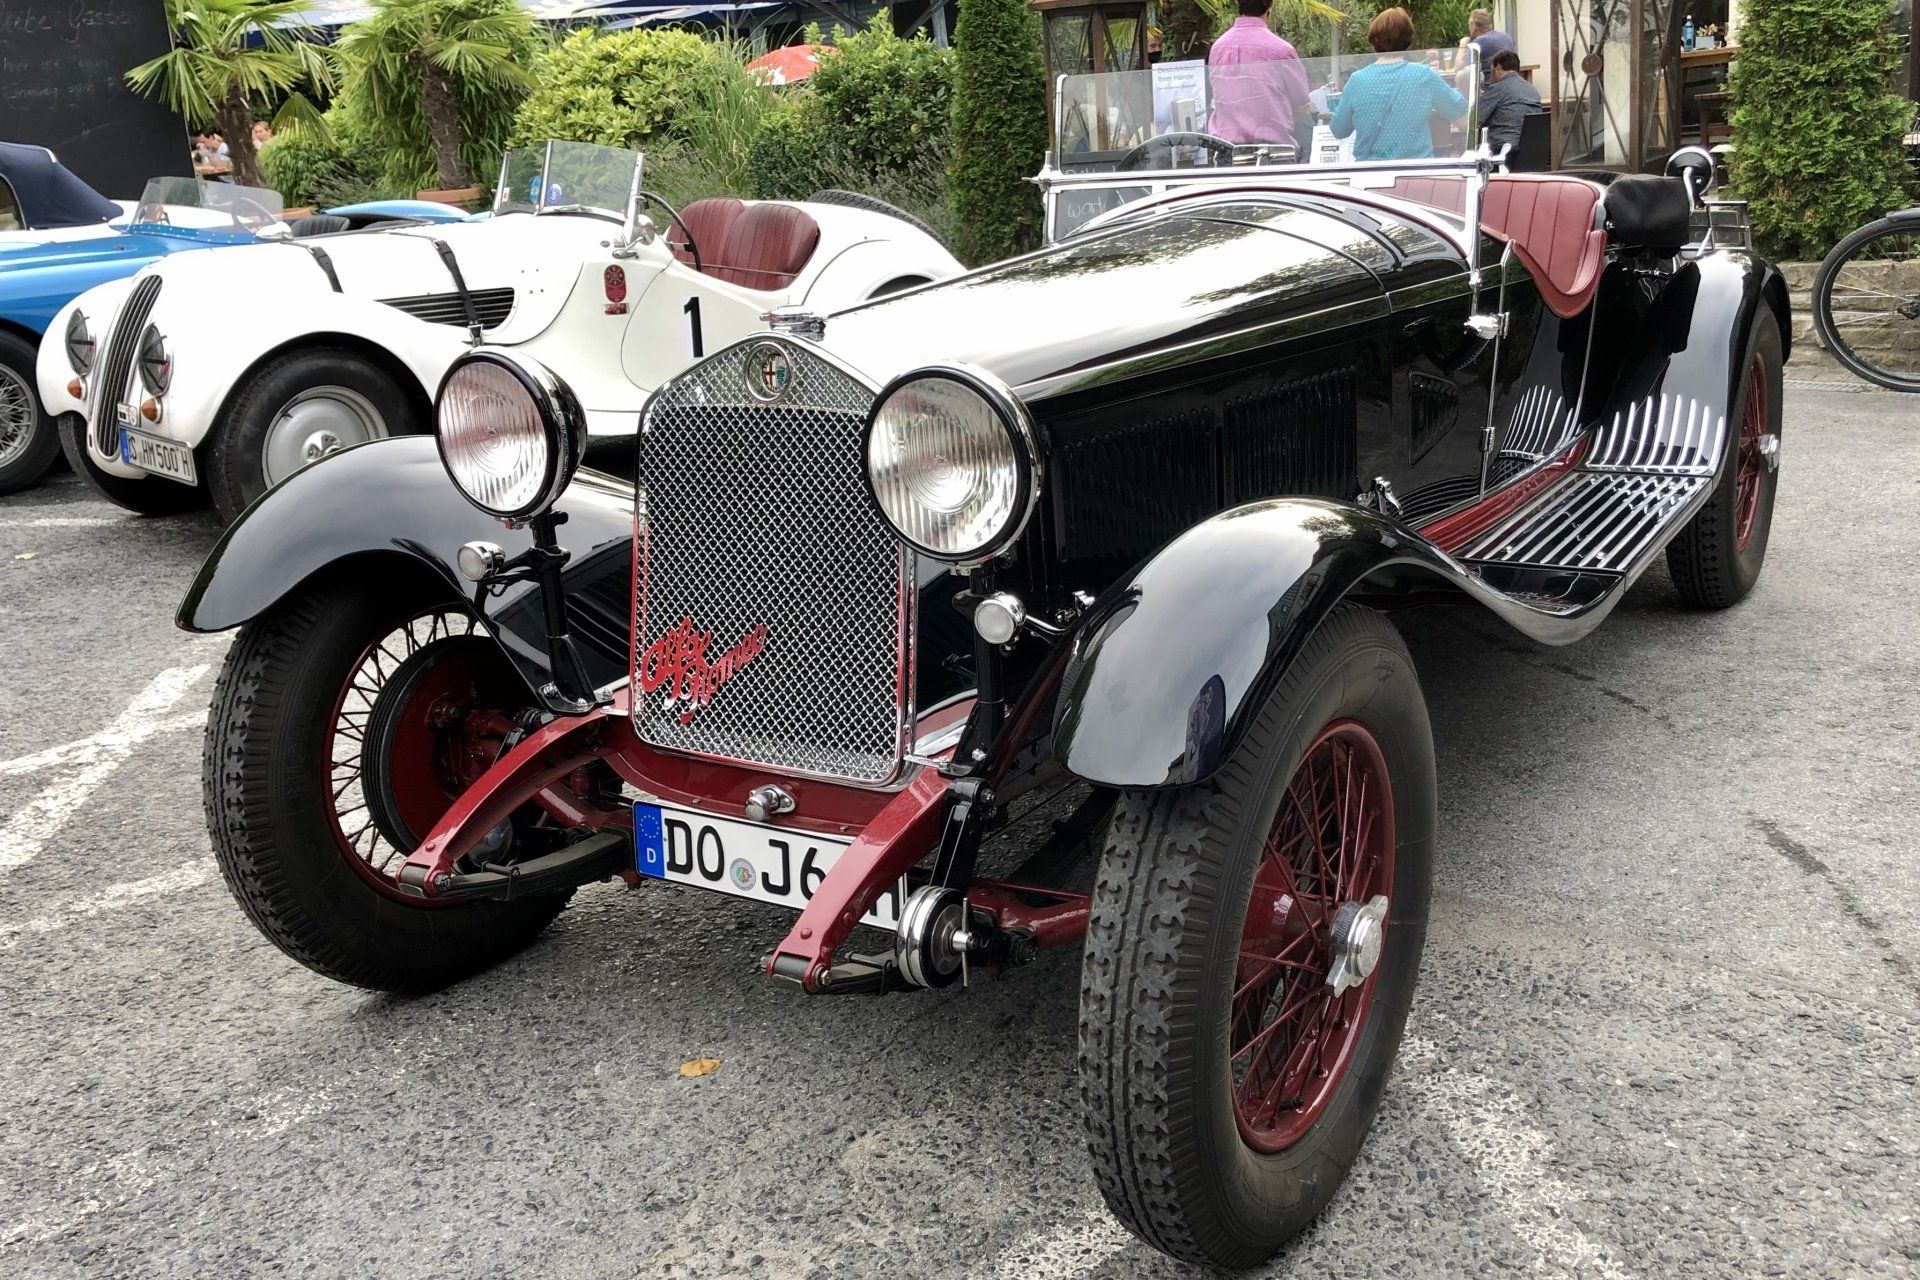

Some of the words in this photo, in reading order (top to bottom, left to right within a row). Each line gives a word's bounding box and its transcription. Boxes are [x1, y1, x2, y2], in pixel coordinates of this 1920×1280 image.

[683, 296, 704, 358] 1
[646, 847, 657, 864] D
[664, 817, 725, 882] DO
